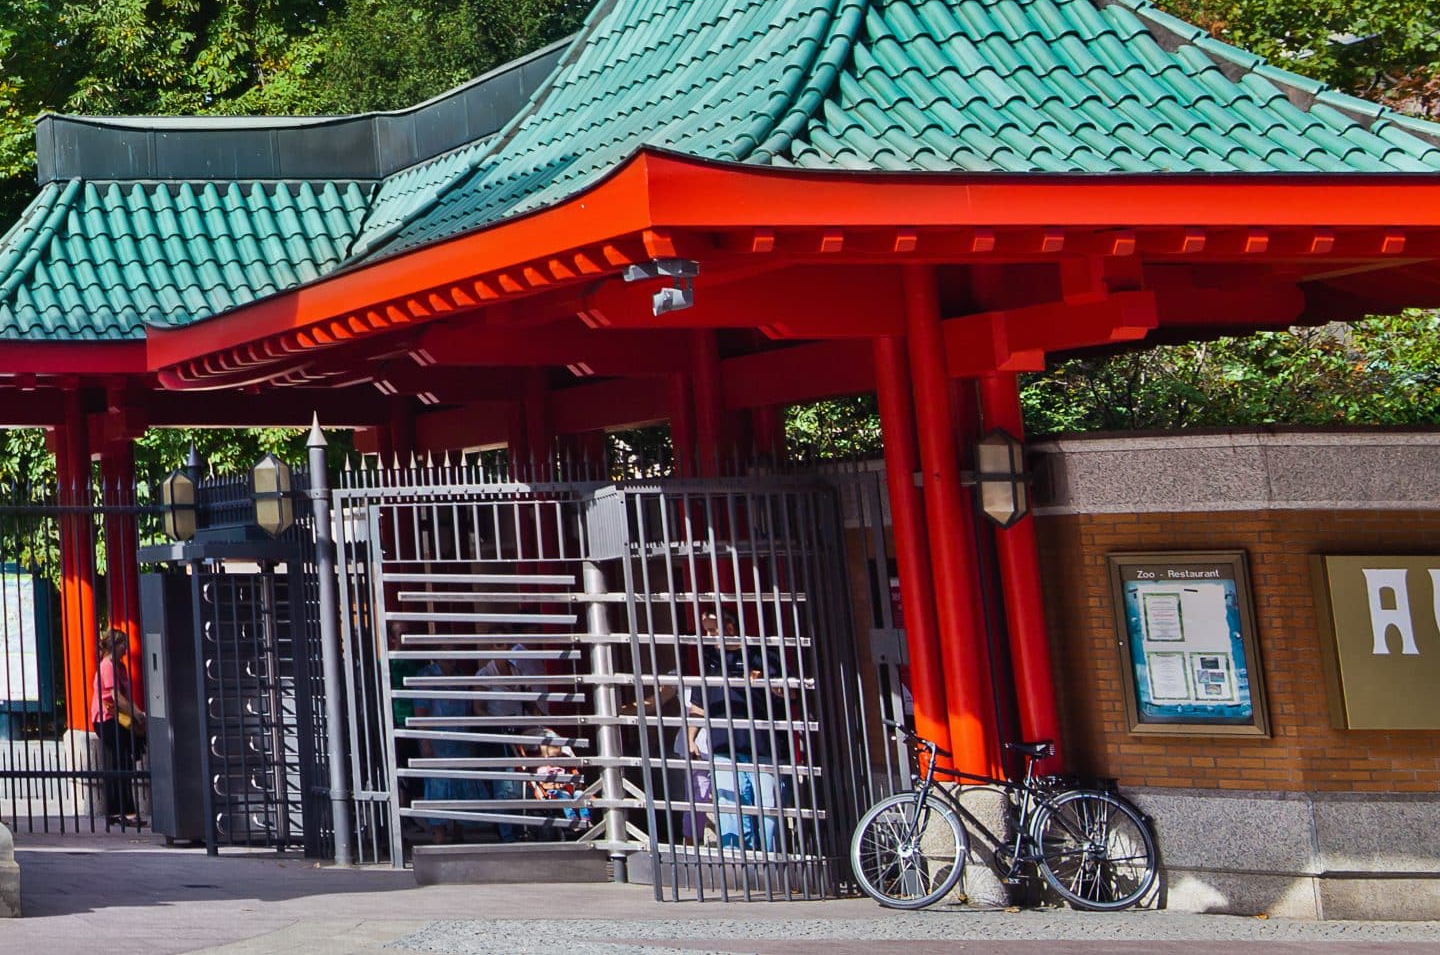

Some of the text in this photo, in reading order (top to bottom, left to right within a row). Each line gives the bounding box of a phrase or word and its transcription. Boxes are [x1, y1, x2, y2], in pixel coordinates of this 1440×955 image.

[1136, 570, 1156, 579] Zoo
[1167, 568, 1220, 579] Restaurant
[1361, 568, 1440, 654] A
